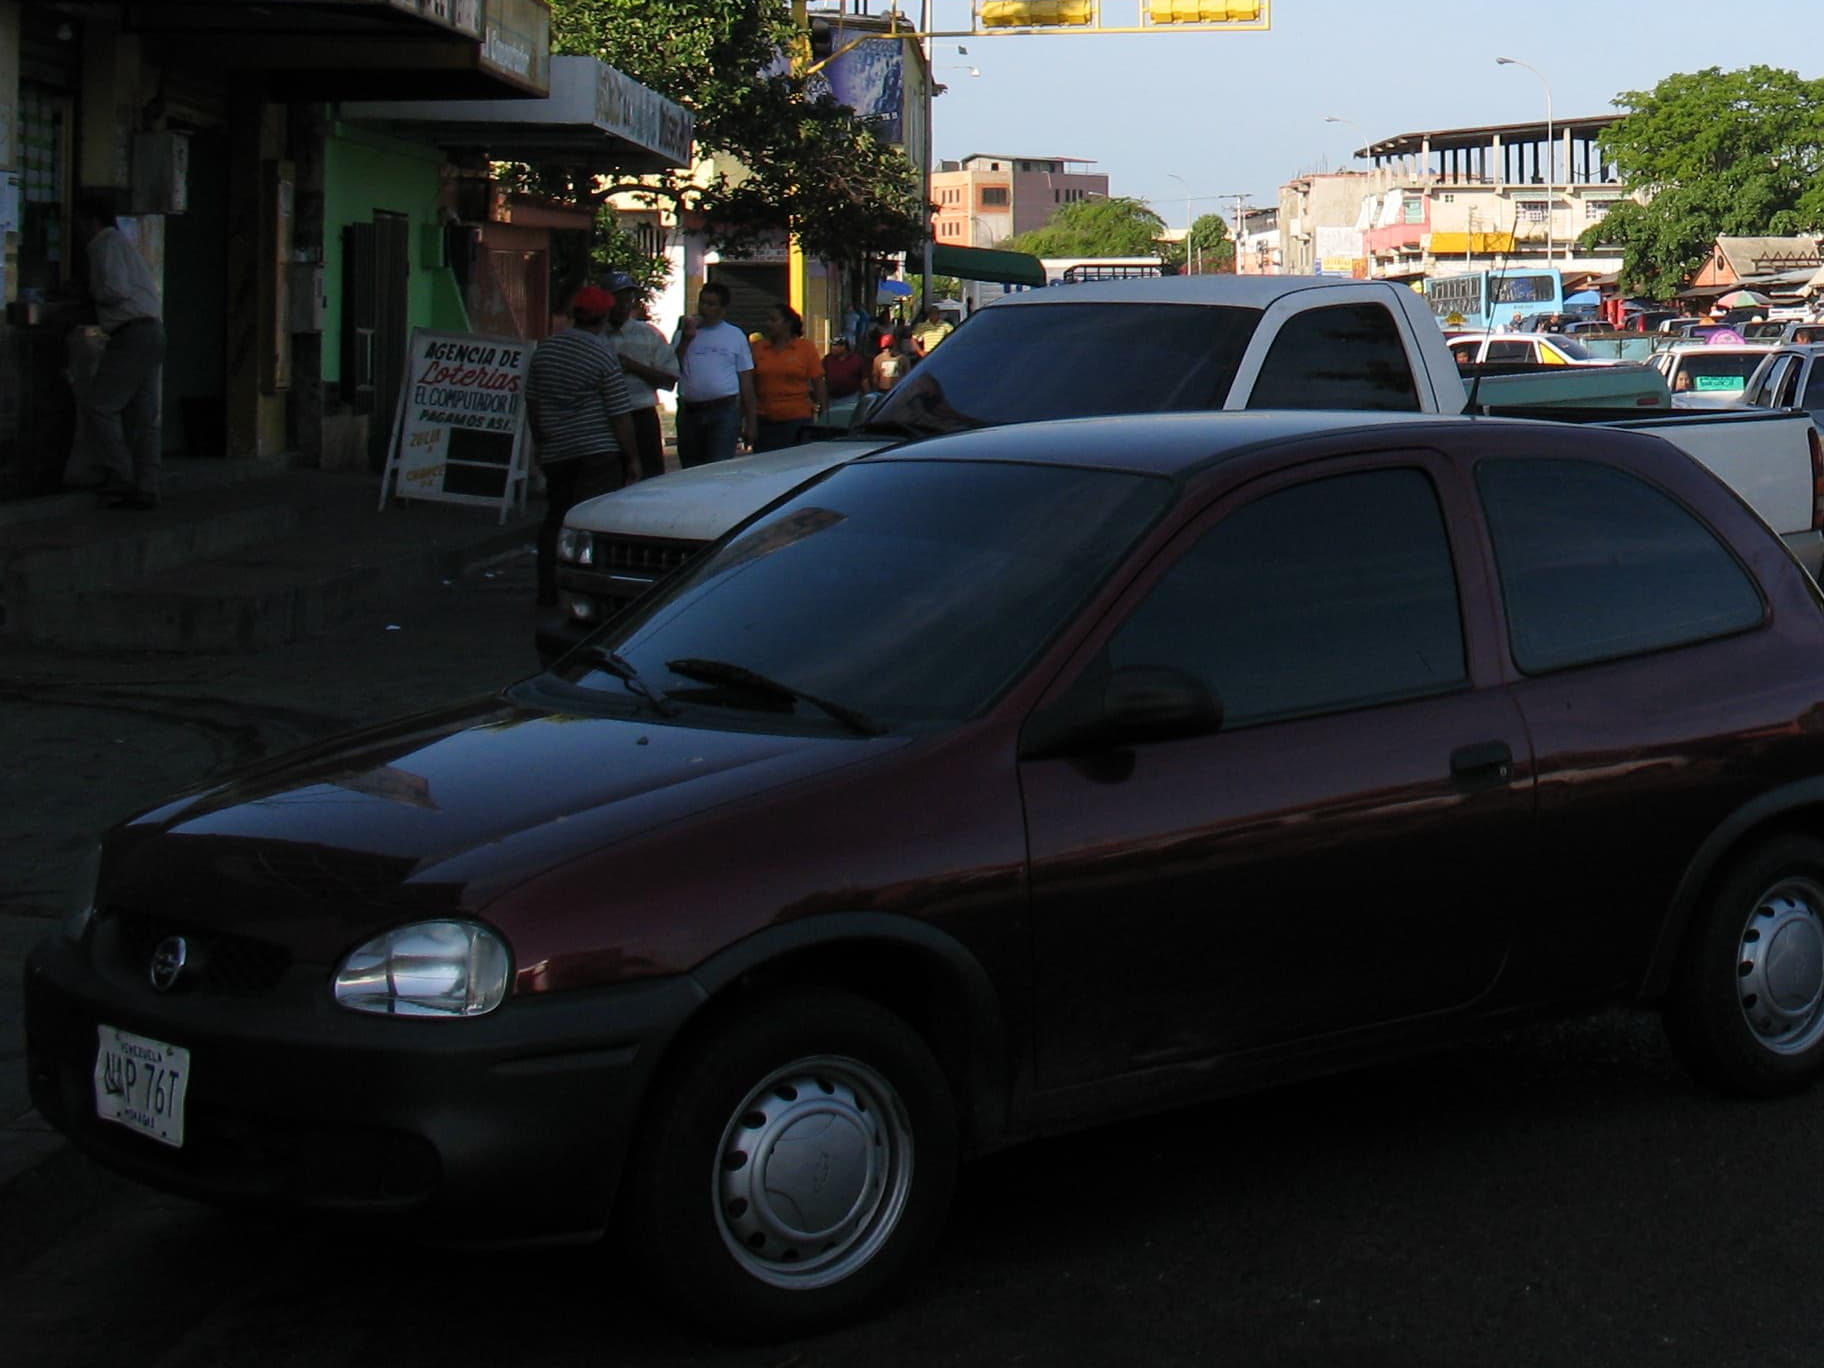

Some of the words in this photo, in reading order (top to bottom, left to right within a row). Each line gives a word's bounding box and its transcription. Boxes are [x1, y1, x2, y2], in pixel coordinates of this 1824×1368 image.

[424, 342, 497, 367] AGENCIA
[499, 350, 521, 368] DE
[418, 361, 521, 392] Loterias
[415, 385, 427, 405] EL
[429, 388, 507, 413] COMPUTADOR
[419, 409, 485, 428] PAGAMOS
[121, 1043, 162, 1062] VENEZUELA
[145, 1063, 179, 1119] 76T
